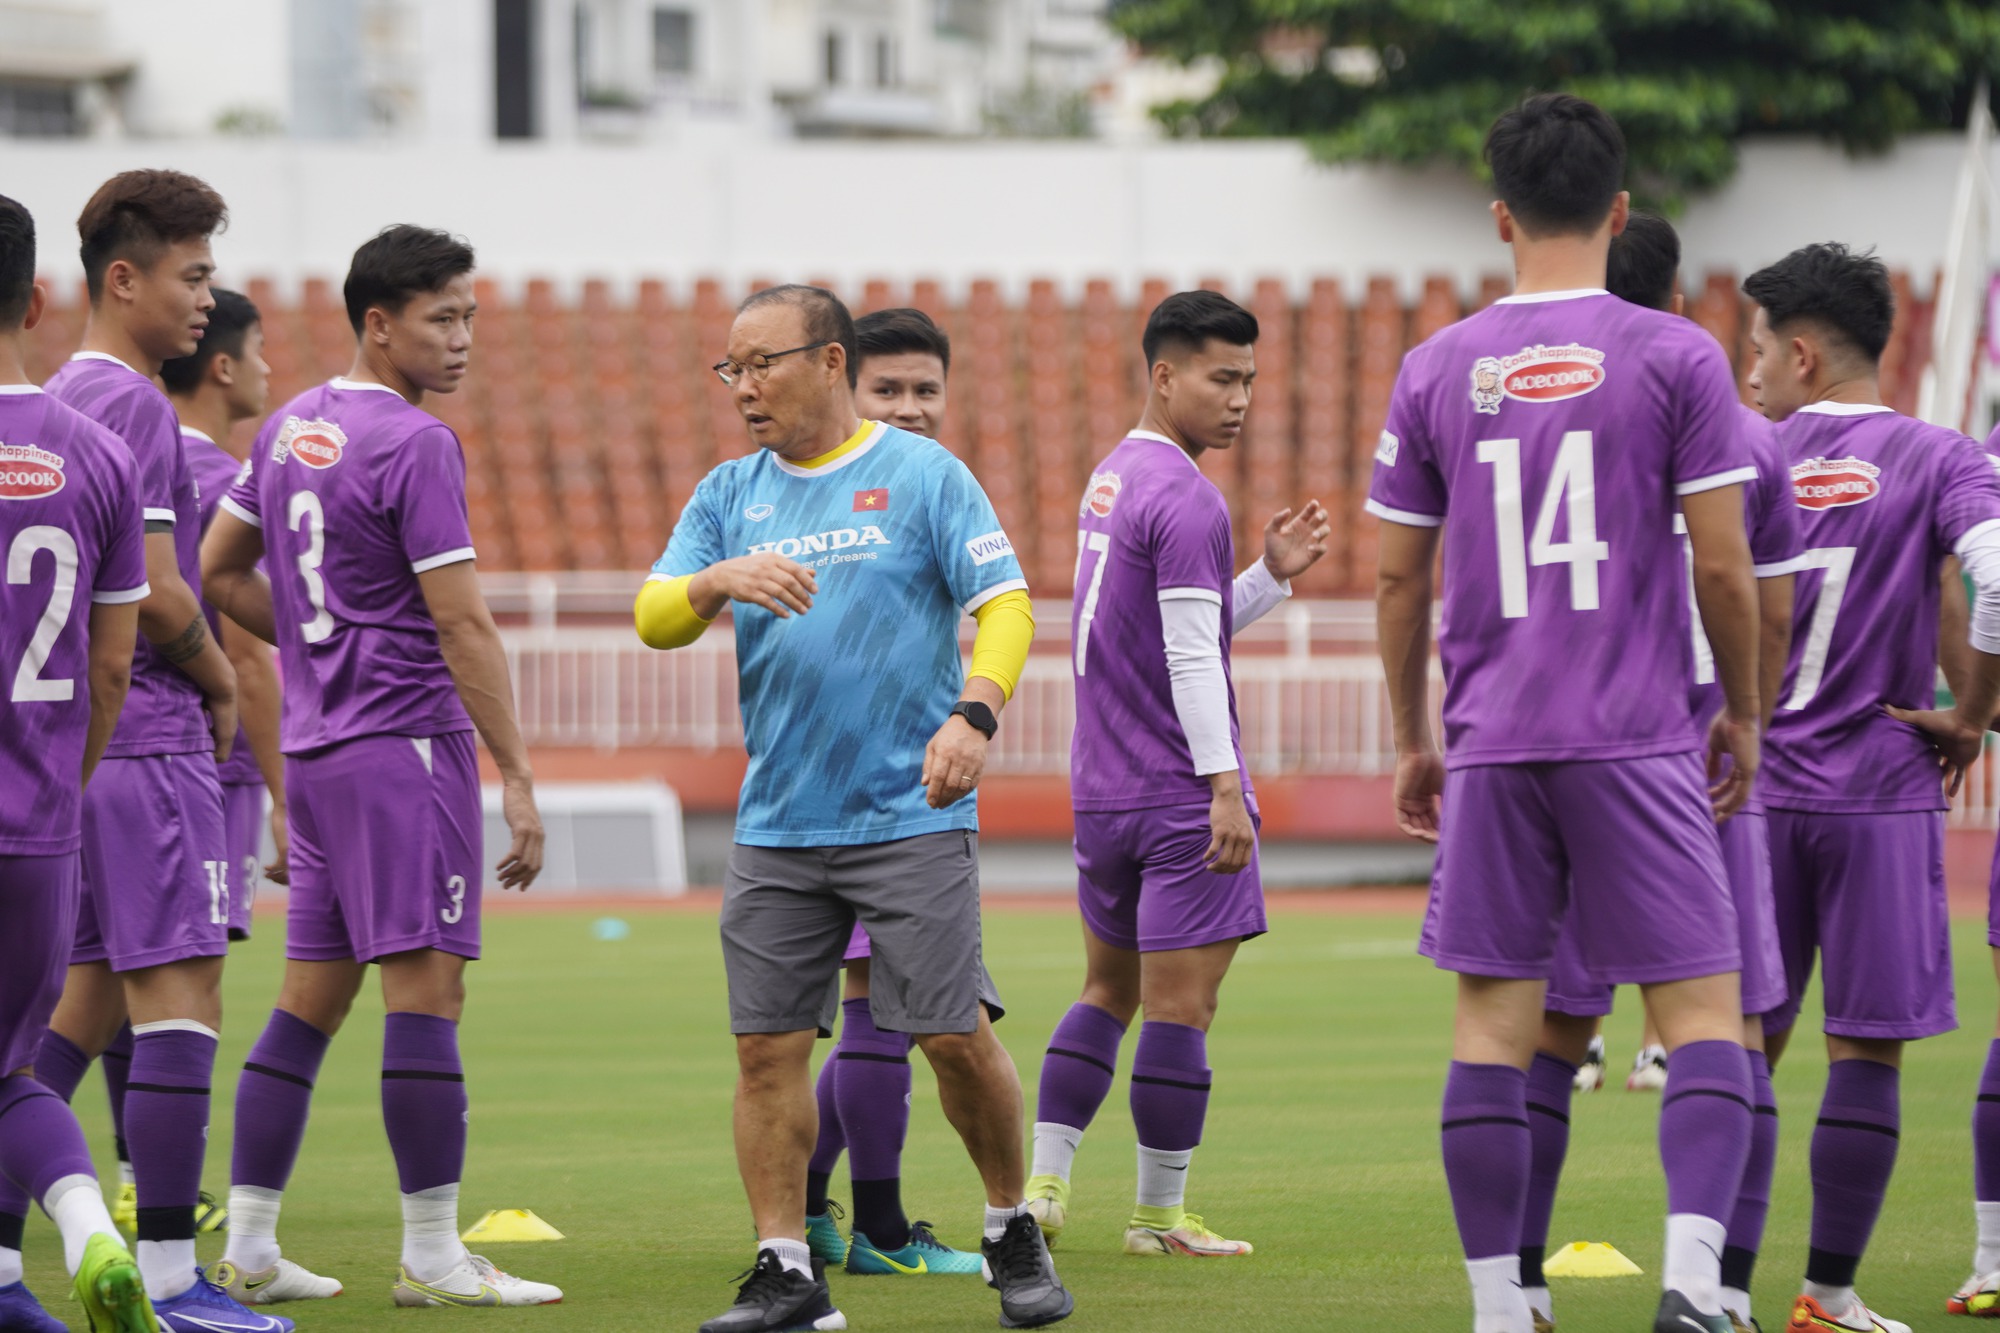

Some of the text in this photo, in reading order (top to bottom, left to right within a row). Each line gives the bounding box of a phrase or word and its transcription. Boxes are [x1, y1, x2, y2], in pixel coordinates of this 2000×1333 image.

[1502, 346, 1603, 369] Cook happiness
[0, 444, 62, 466] happiness
[1790, 460, 1816, 476] ook
[1476, 430, 1609, 618] 14
[747, 525, 892, 560] HONDA
[971, 536, 1011, 557] VINA
[288, 490, 335, 644] 3
[817, 555, 830, 567] of
[831, 551, 878, 564] Dreams
[7, 525, 79, 702] 2
[441, 874, 466, 924] 3
